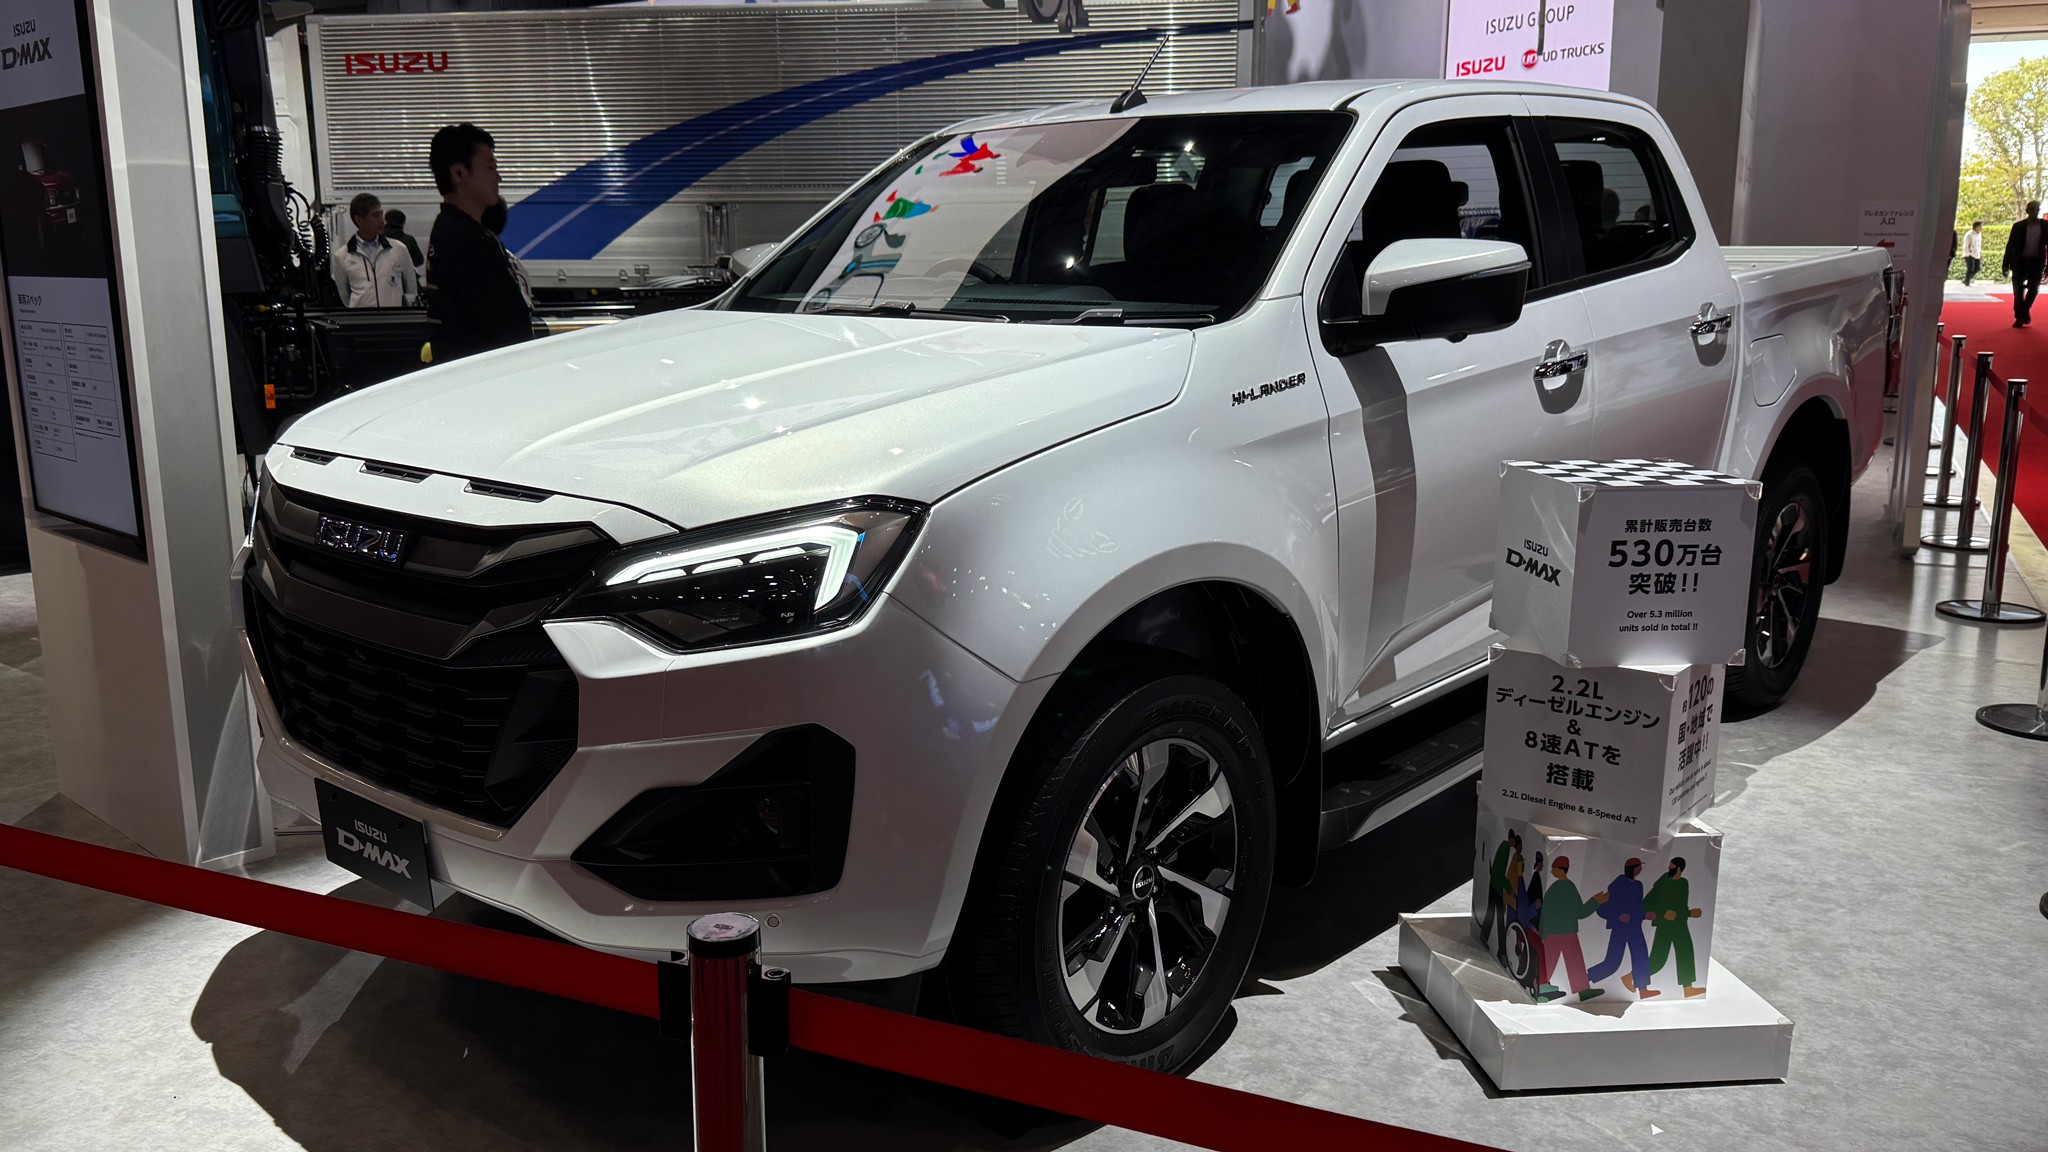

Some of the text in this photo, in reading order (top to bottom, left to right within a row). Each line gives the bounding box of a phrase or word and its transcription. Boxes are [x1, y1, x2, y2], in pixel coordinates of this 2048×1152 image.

[13, 18, 36, 37] ISUZU
[1486, 5, 1574, 34] ISUZU GOUP
[345, 52, 448, 74] ISUZU
[1522, 53, 1538, 64] UD
[1543, 43, 1604, 62] UD TRUCKS
[1456, 56, 1506, 77] ISUZU
[1880, 217, 1895, 225] 入口
[1232, 372, 1306, 406] HI-LANDER
[1624, 518, 1712, 534] 累計販売台数
[316, 516, 404, 563] ISUZU
[1524, 539, 1548, 556] ISUZU
[1608, 539, 1722, 568] 530万台
[1627, 610, 1693, 618] Over 5.3 million
[1619, 624, 1639, 632] units
[1670, 623, 1690, 631] total
[1550, 675, 1603, 700] 2.2L
[1496, 688, 1660, 728] ディーゼルエンジン
[1567, 719, 1581, 736] &
[1525, 731, 1621, 765] 8速ATを
[1547, 763, 1594, 792] 搭載
[1502, 789, 1637, 824] 2.2L Diesel Engine & 8-Speed AT
[354, 819, 387, 844] ISUZU
